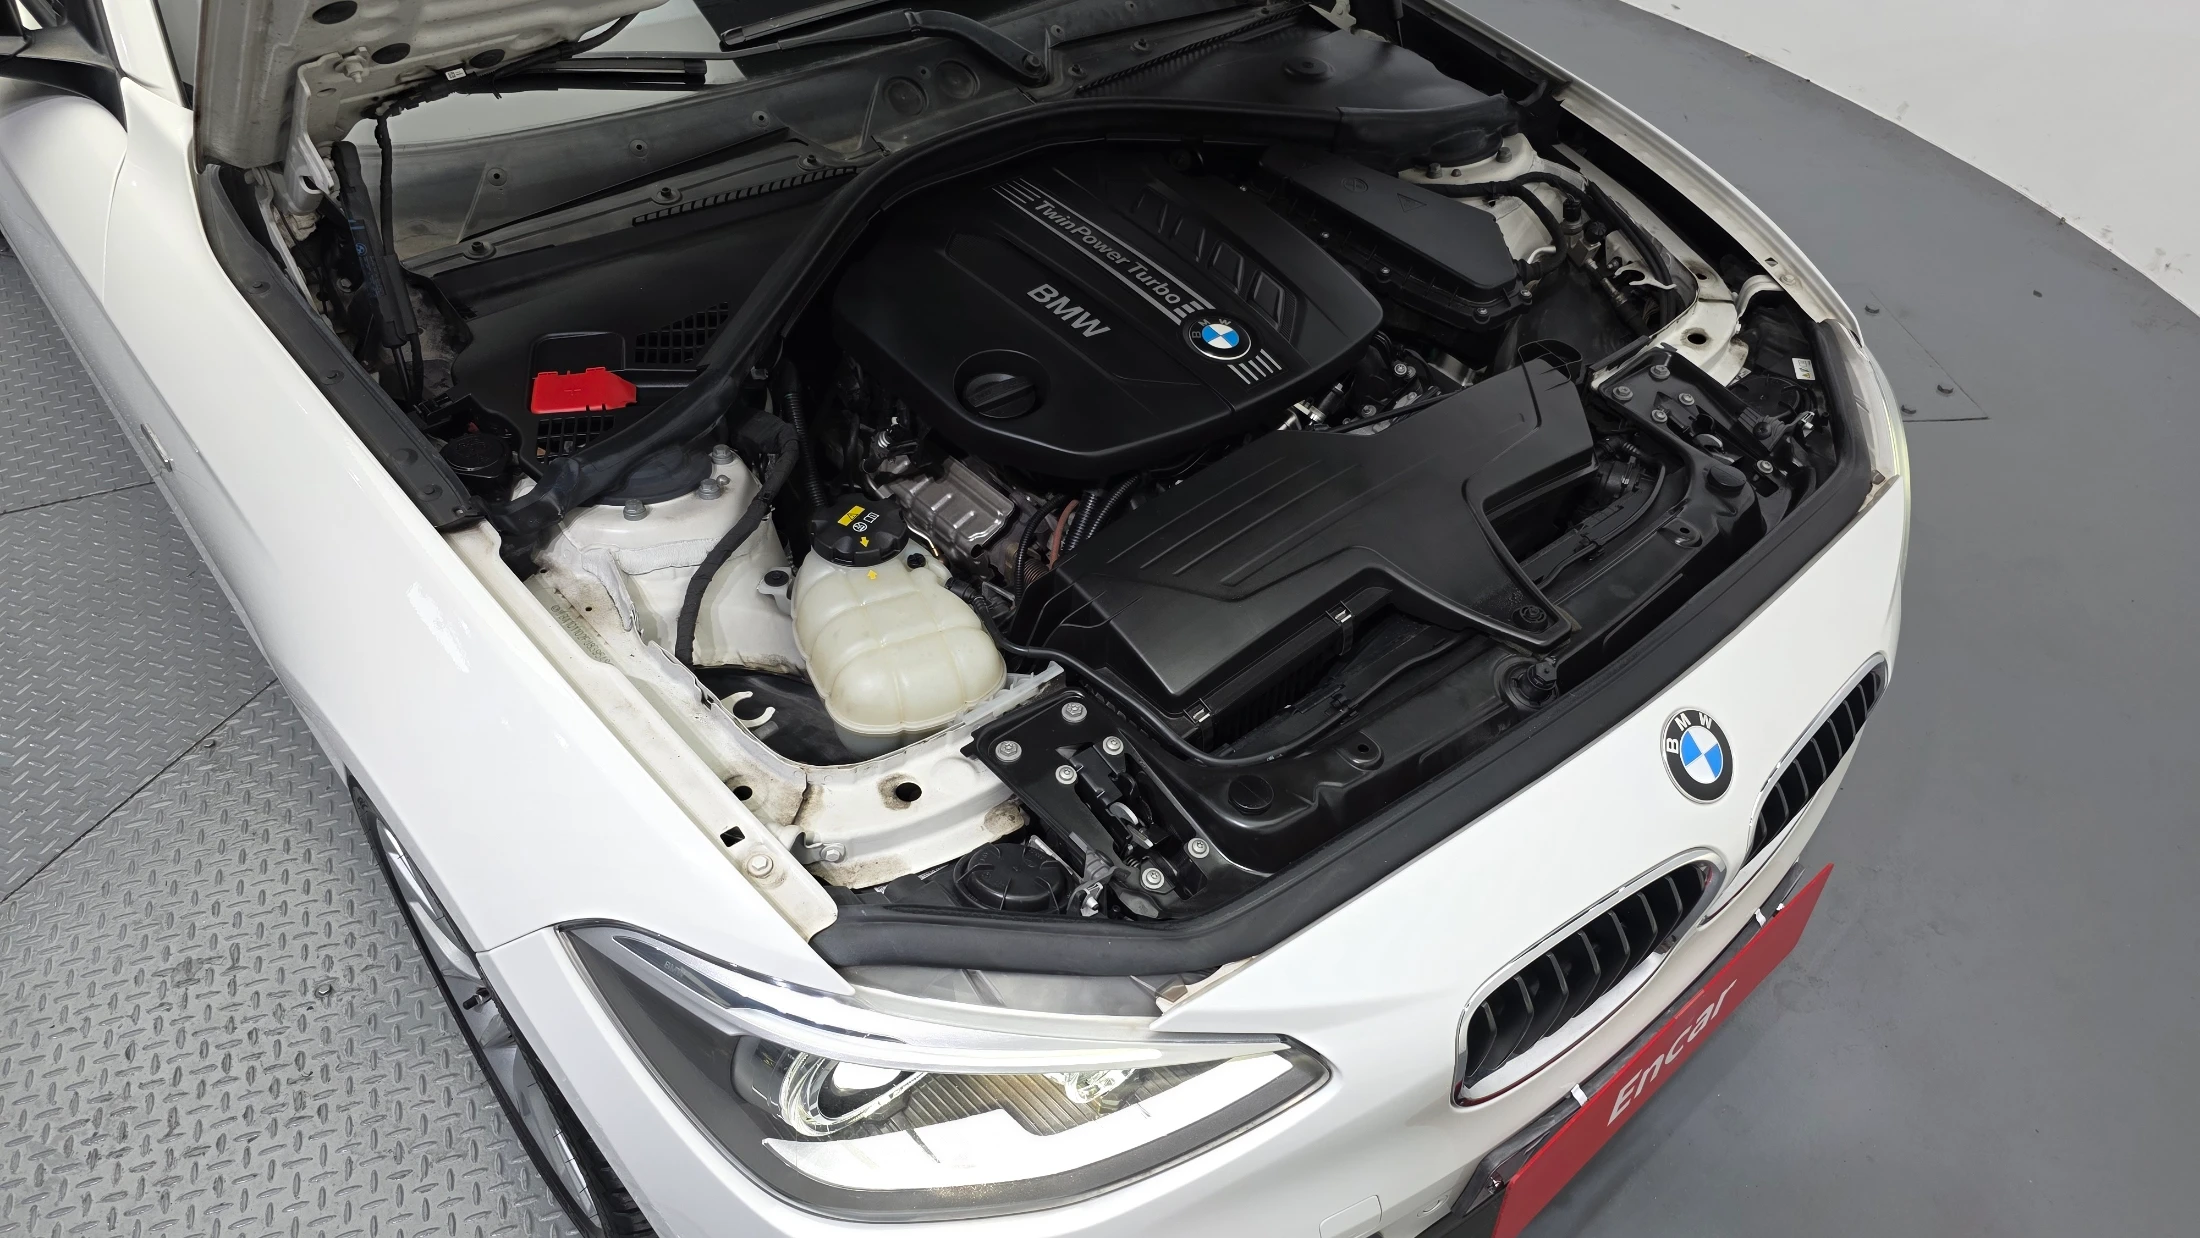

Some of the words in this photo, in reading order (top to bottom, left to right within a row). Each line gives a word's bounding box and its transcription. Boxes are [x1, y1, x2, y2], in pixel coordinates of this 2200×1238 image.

[1035, 200, 1131, 265] TwinPower
[1126, 261, 1181, 305] Turbo
[1026, 283, 1111, 338] BMW
[1191, 318, 1232, 339] BMW
[1666, 711, 1713, 755] BMW
[1607, 978, 1737, 1127] Encar
